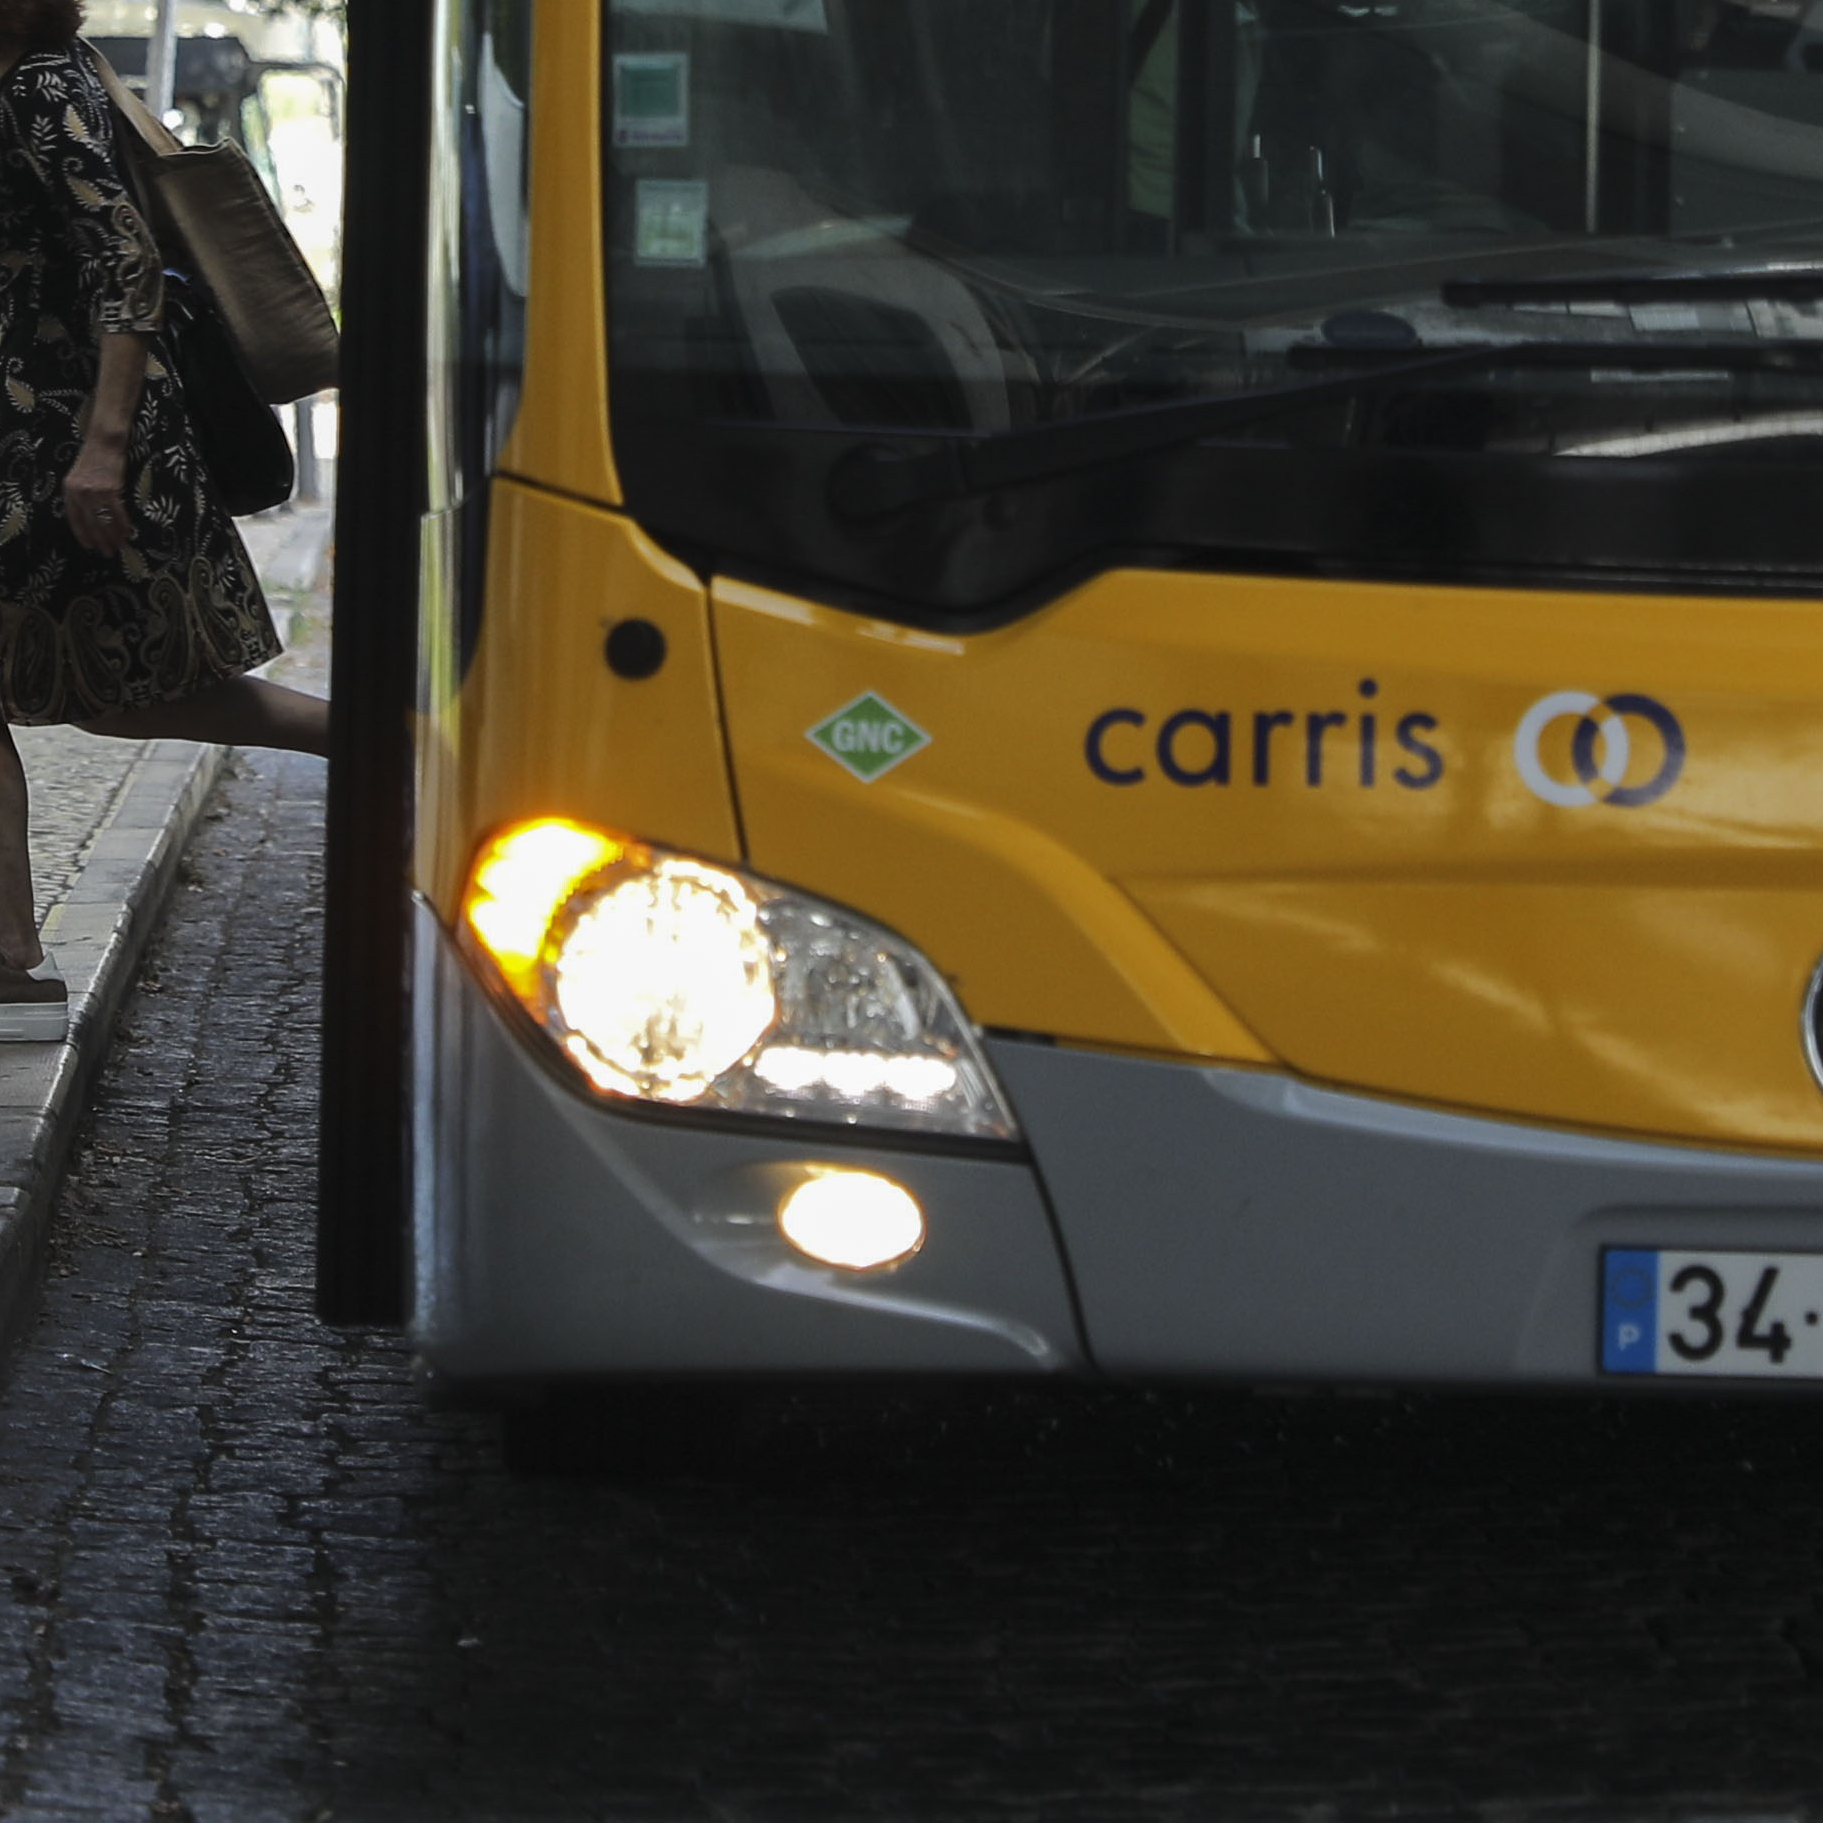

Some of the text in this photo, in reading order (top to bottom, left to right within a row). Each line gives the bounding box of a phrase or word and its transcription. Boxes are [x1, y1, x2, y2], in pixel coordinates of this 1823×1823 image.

[830, 718, 905, 754] GNC
[1084, 678, 1445, 788] carris
[1618, 1322, 1641, 1351] P
